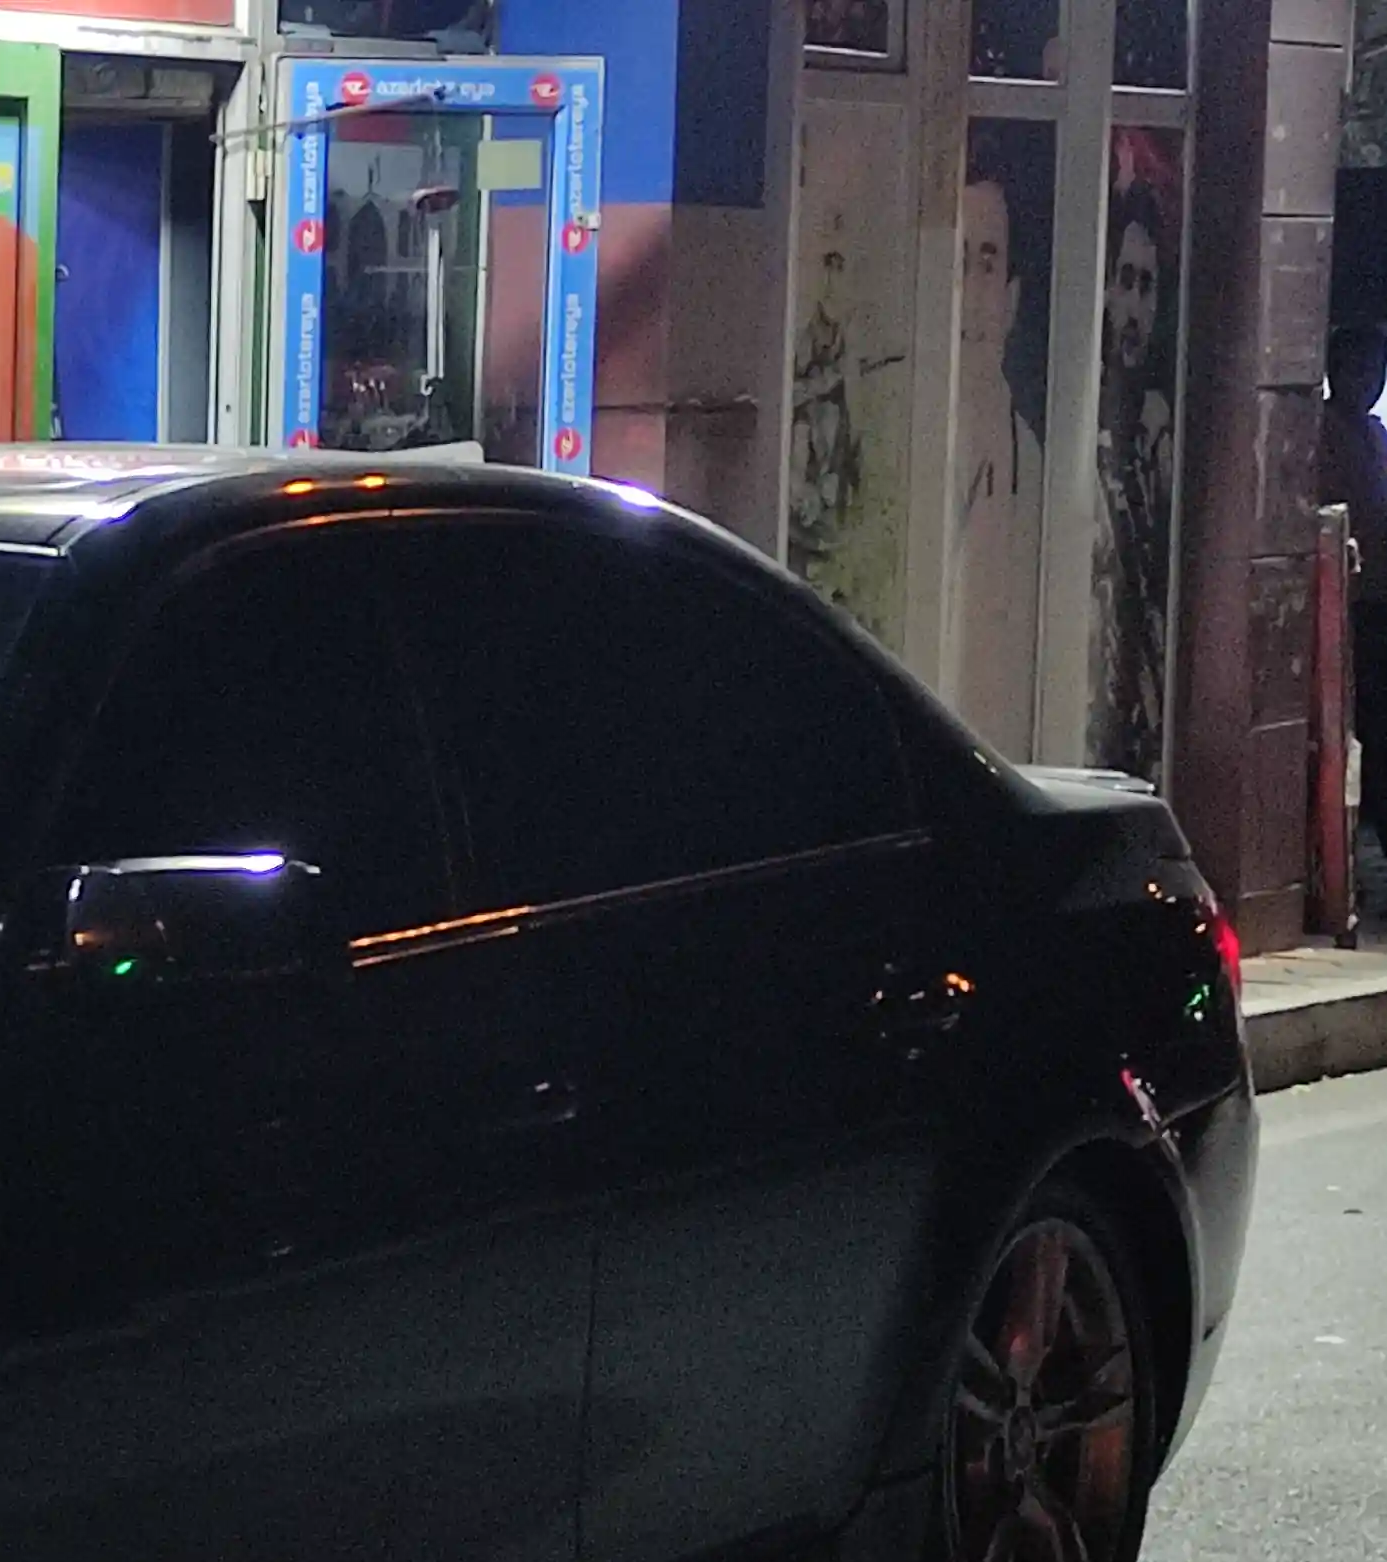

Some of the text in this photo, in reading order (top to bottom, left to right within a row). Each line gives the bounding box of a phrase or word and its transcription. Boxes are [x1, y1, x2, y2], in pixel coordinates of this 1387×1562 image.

[300, 82, 321, 213] azarloteya
[377, 76, 495, 100] azarloteya
[297, 293, 317, 423] azarlotereya
[562, 293, 582, 423] azarlotereya
